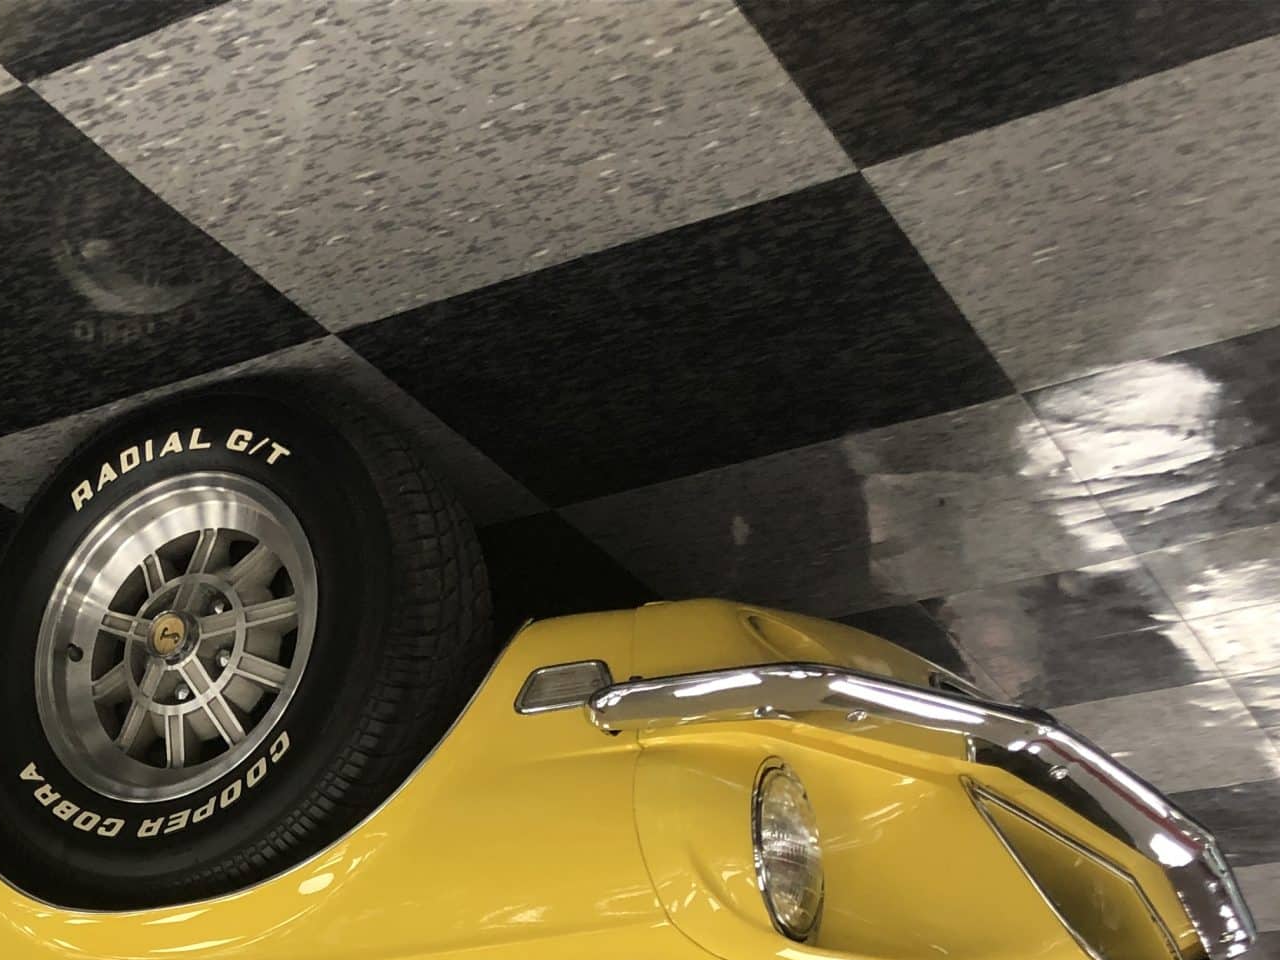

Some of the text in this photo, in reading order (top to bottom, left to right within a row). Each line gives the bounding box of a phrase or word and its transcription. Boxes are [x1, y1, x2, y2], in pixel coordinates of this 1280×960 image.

[71, 428, 291, 512] RADIAL G/T
[19, 730, 290, 838] COOPER COBRA
